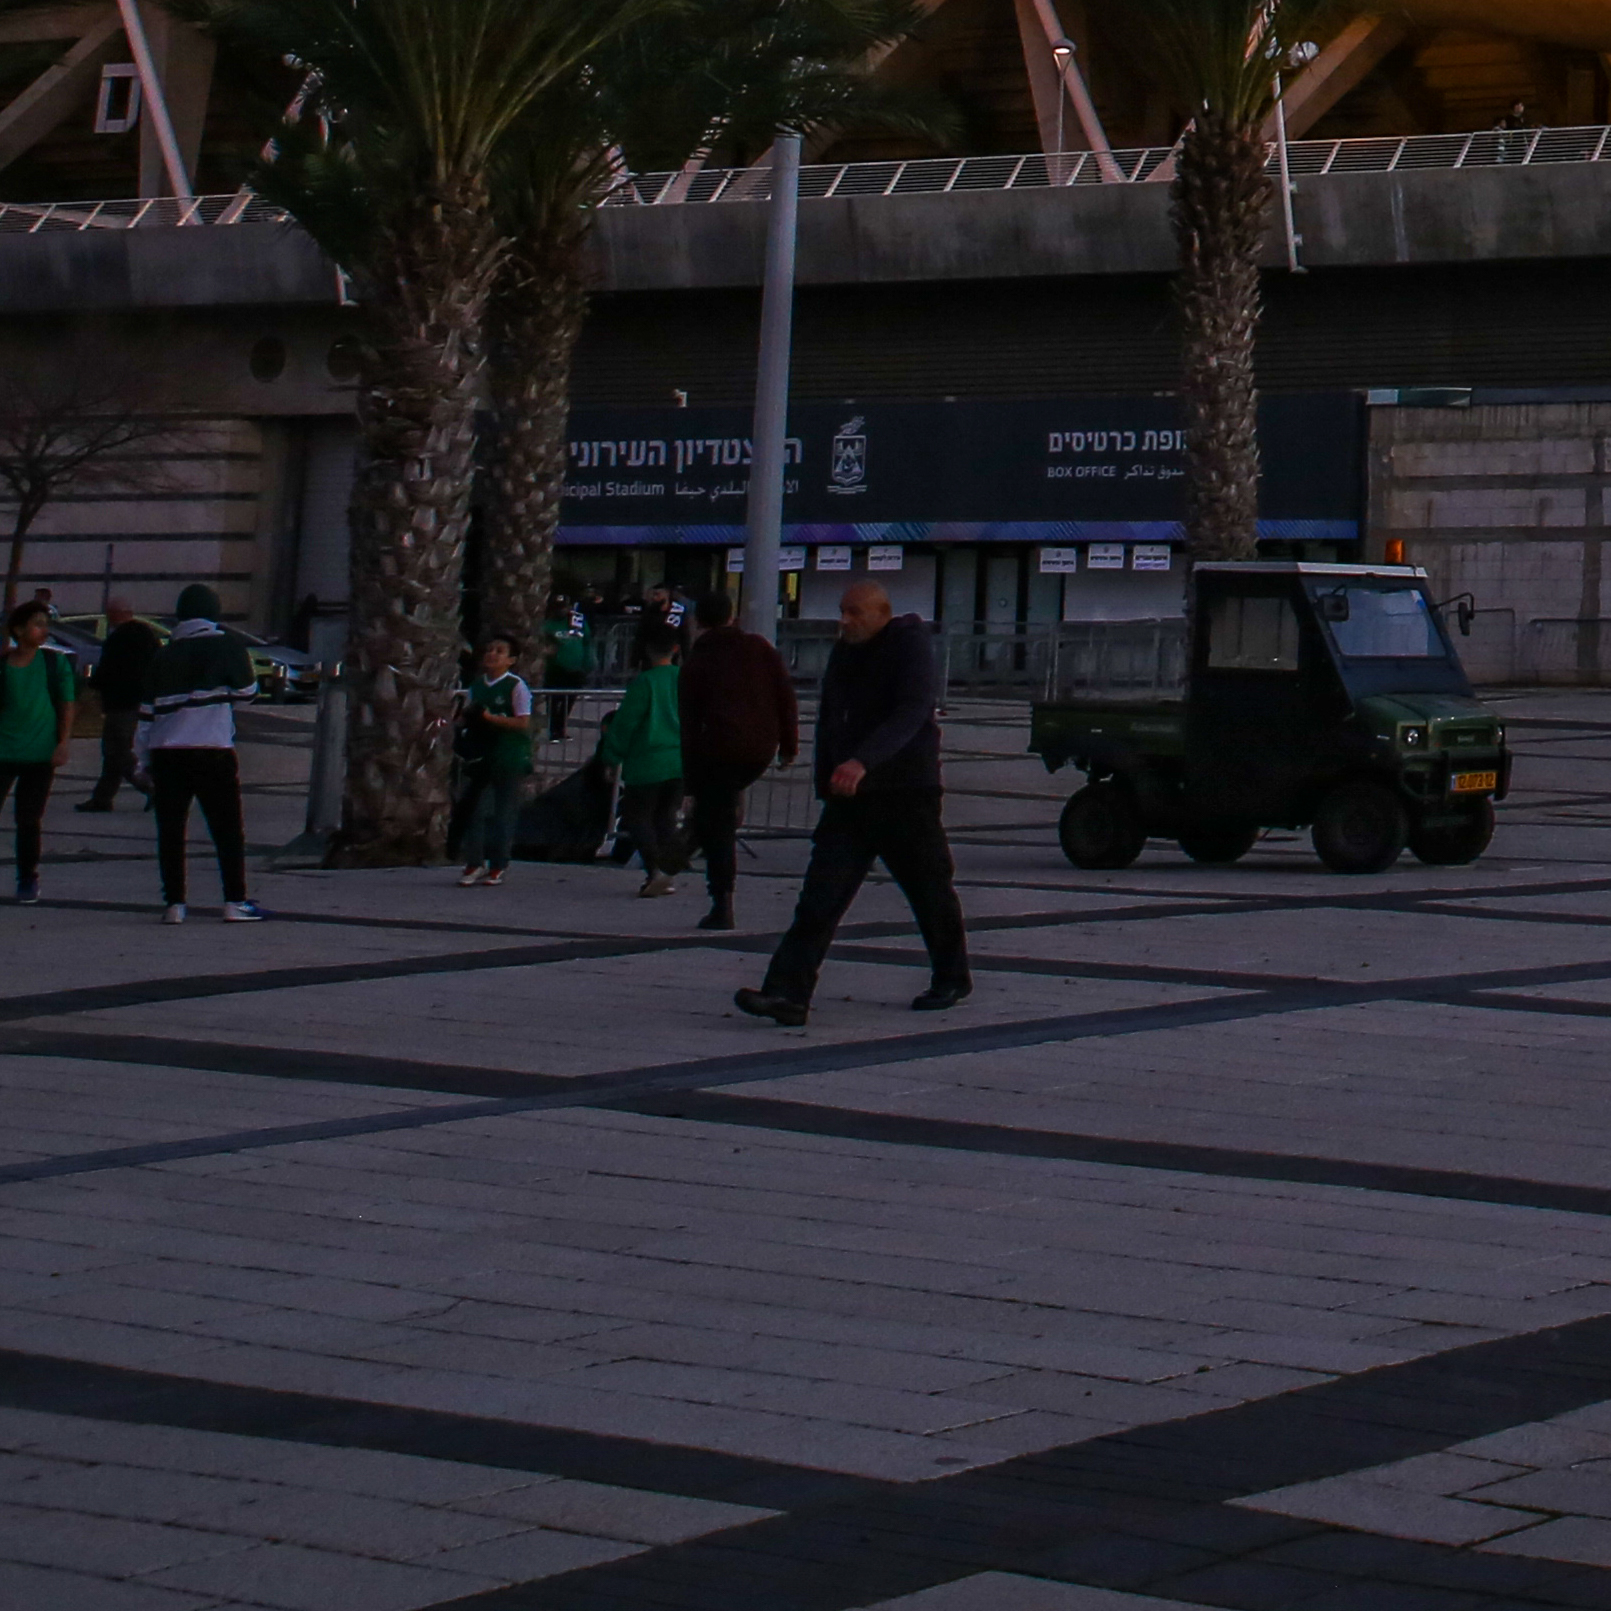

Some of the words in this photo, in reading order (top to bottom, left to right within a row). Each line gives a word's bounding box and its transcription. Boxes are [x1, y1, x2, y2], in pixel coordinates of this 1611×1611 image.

[1048, 430, 1137, 453] כרטיסים
[1141, 429, 1187, 452] ופת
[569, 439, 667, 467] העירוני
[674, 437, 803, 474] הצטדיון
[1047, 466, 1073, 478] BOX
[1074, 465, 1117, 477] OFFICE
[605, 480, 665, 496] Stadium
